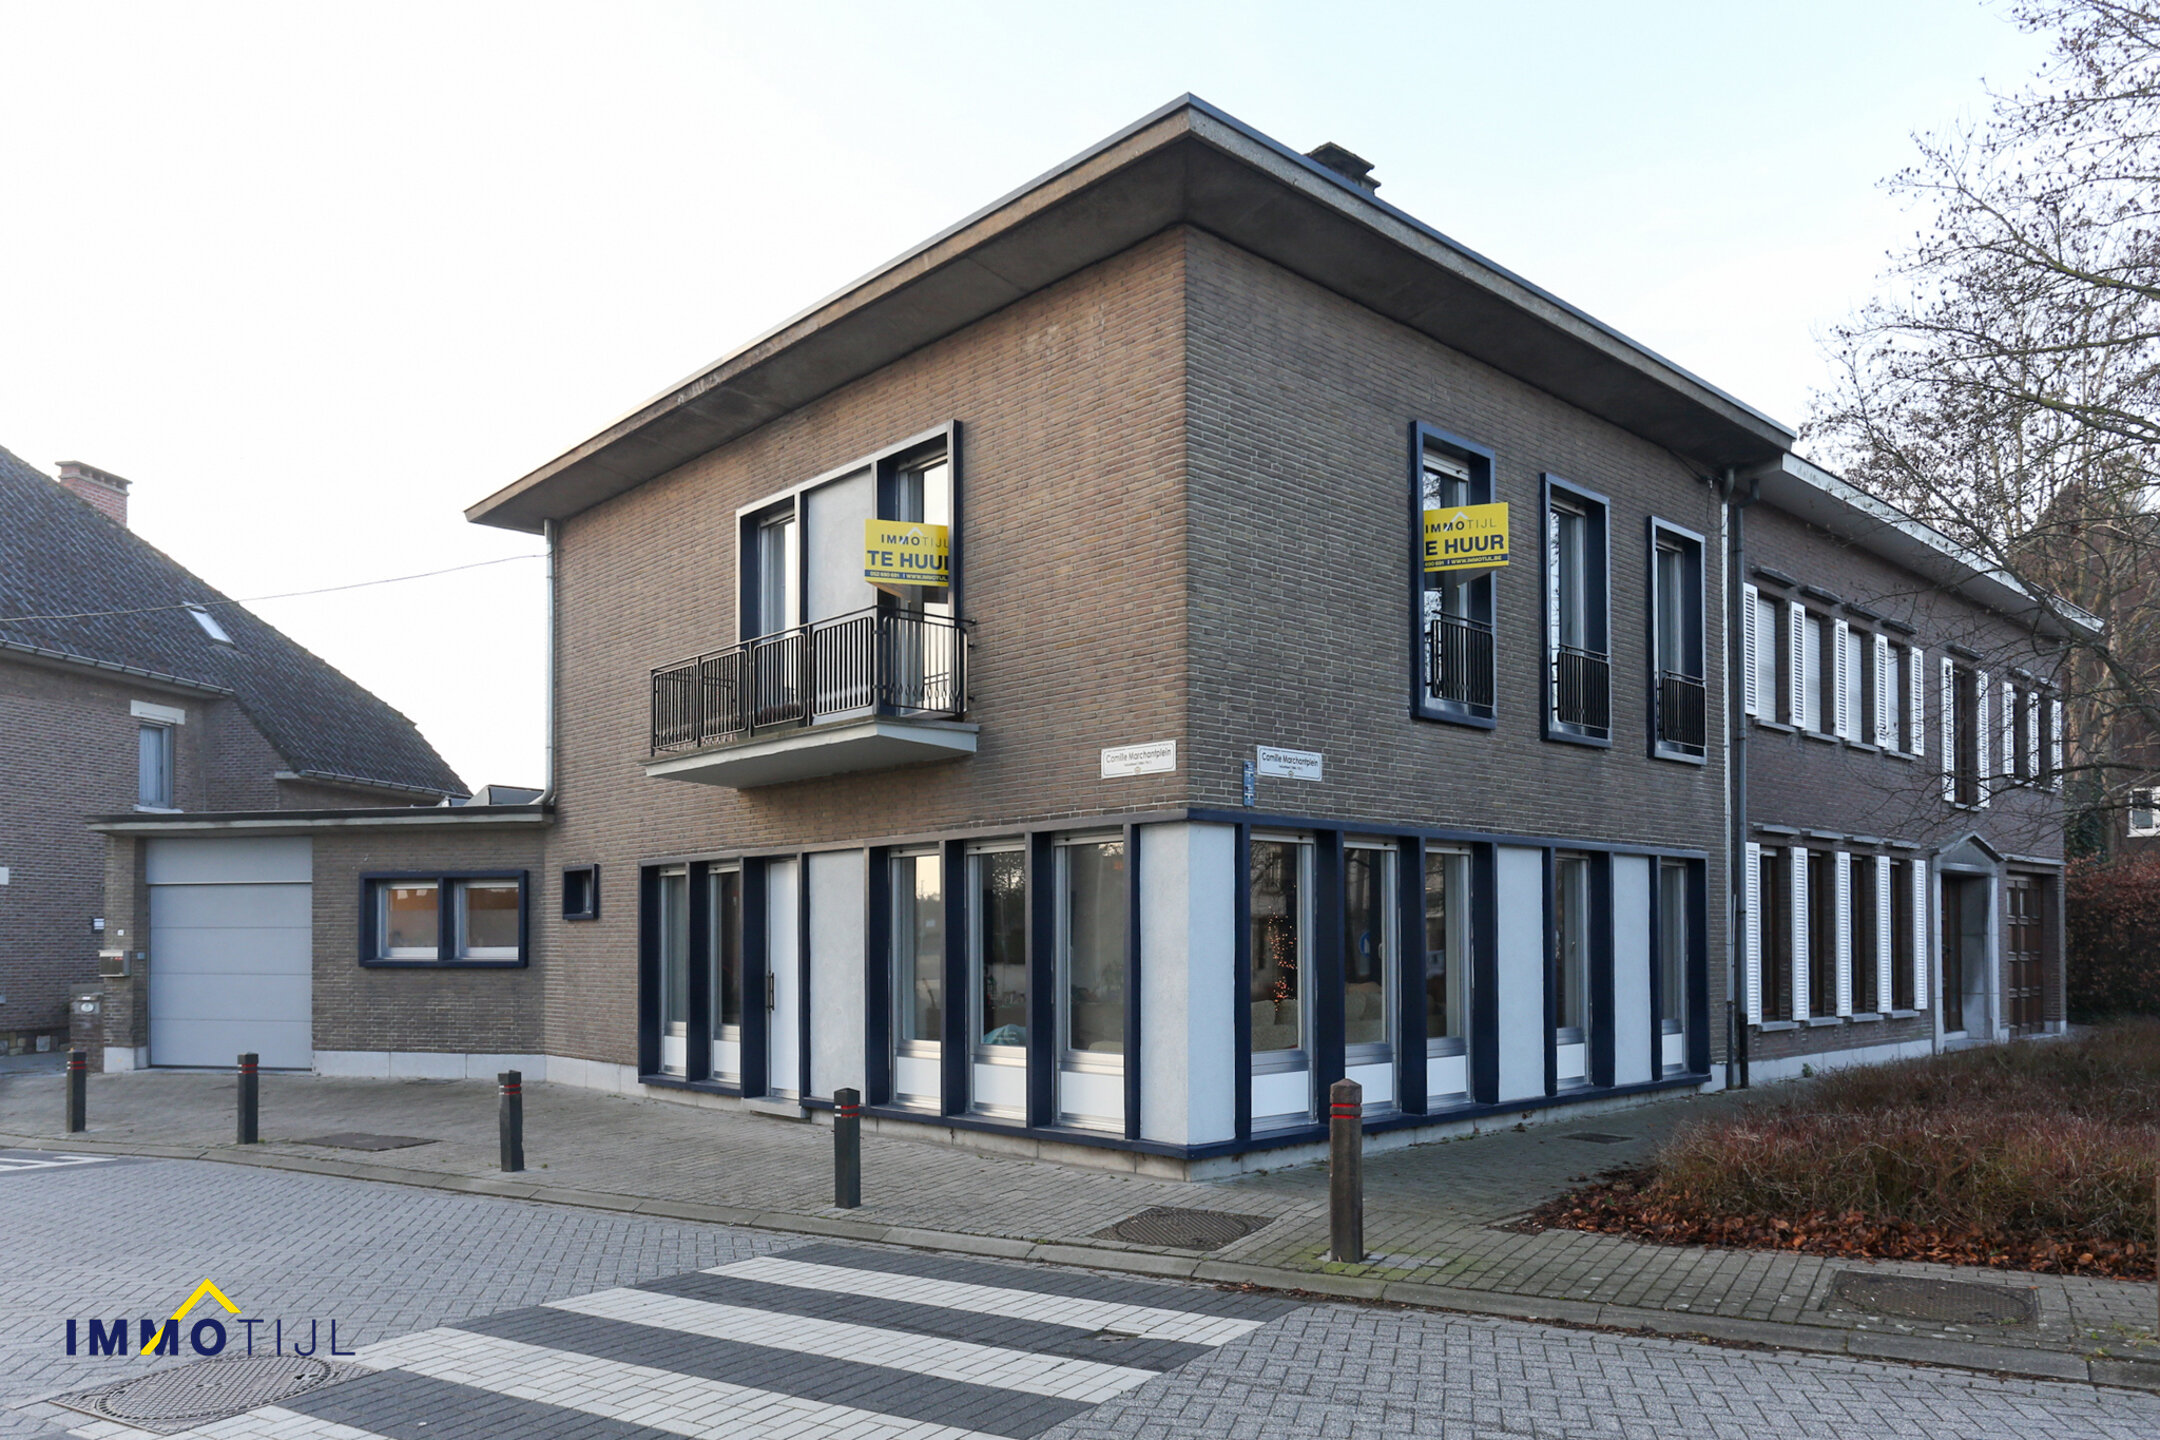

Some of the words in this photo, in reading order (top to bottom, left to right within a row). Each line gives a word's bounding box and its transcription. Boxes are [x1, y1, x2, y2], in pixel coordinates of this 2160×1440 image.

[1425, 517, 1497, 534] IMMOTIJL
[1425, 540, 1438, 556] E
[1445, 534, 1504, 554] HUUR
[867, 550, 894, 567] TE
[1106, 753, 1127, 763] Camille
[1128, 747, 1171, 760] Marchantplein
[1262, 752, 1282, 762] Camille
[1283, 755, 1318, 767] Marchantplein
